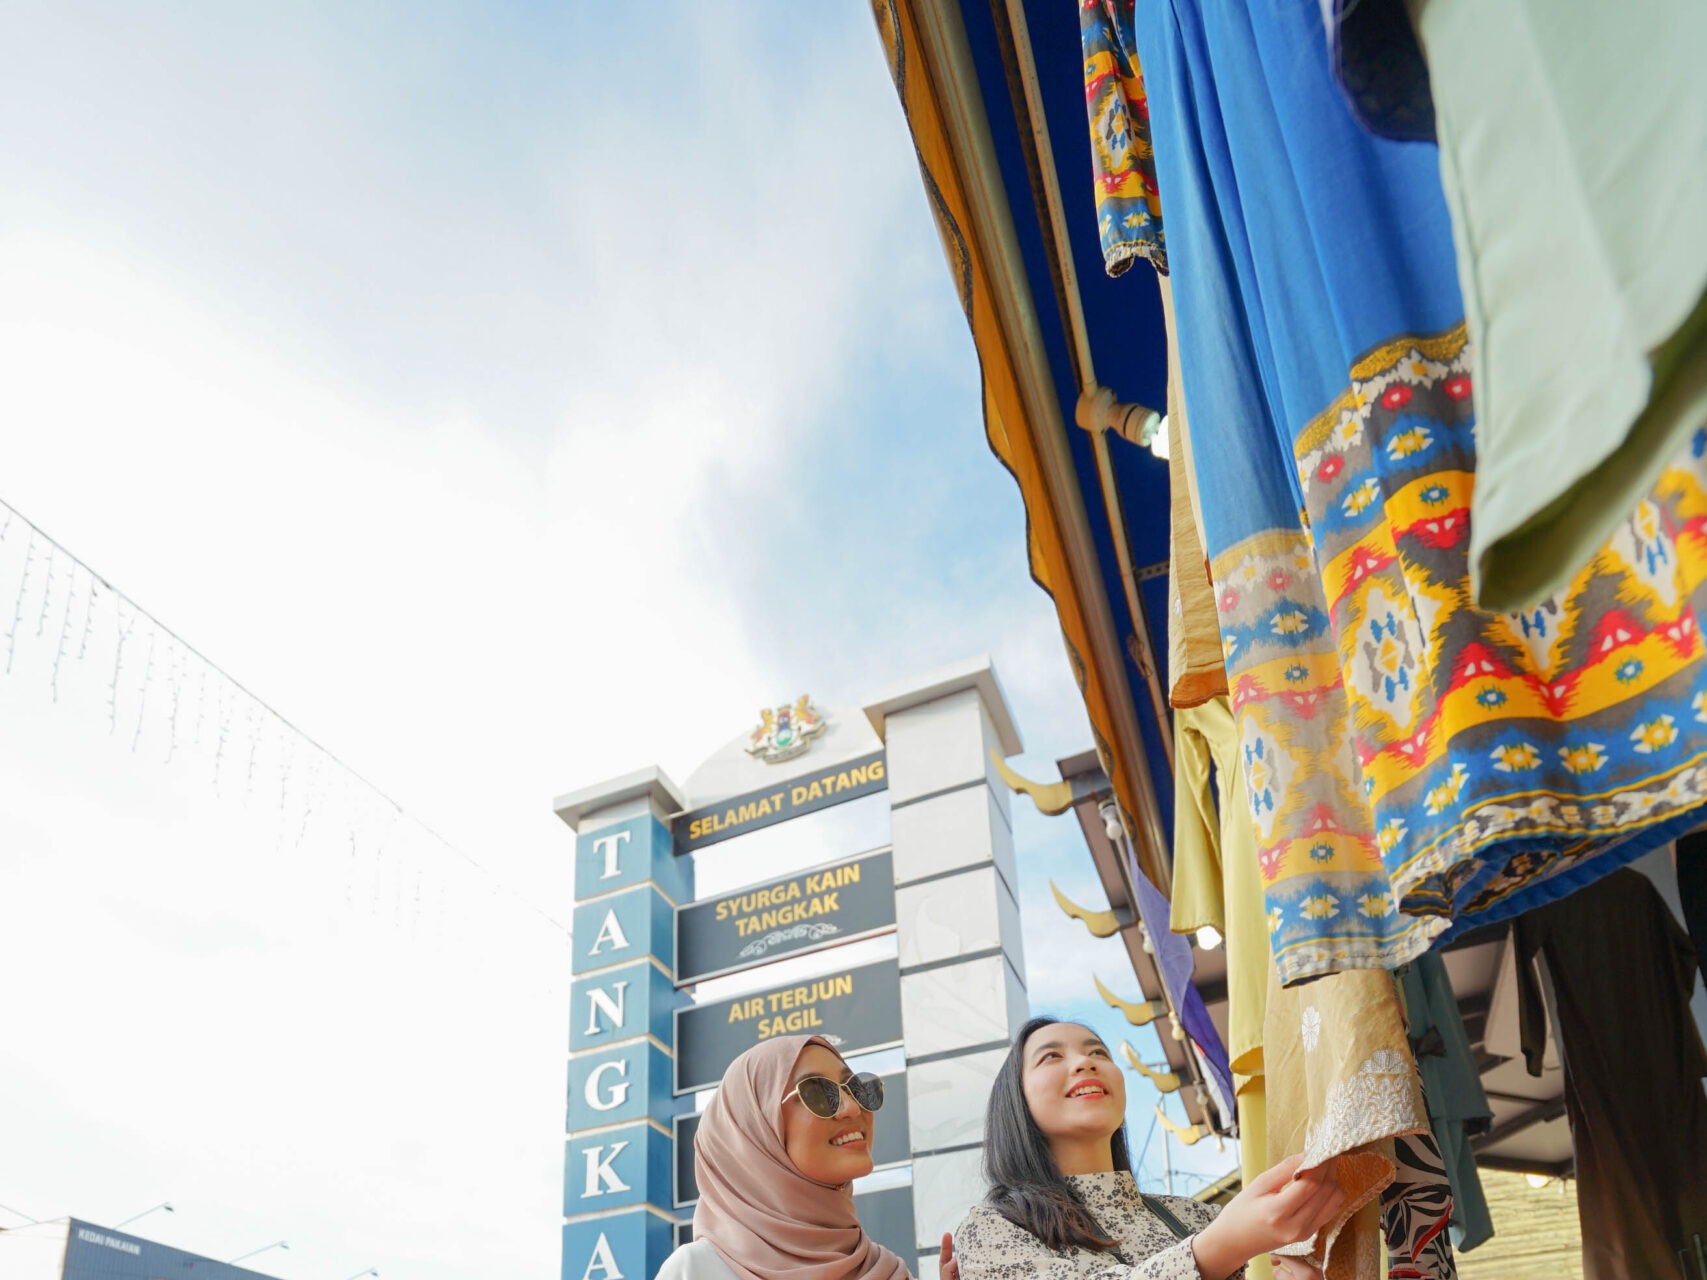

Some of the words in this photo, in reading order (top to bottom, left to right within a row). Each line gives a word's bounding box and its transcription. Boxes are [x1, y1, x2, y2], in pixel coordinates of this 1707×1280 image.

[689, 793, 784, 839] SELAMAT
[791, 761, 885, 806] DATANG
[716, 882, 801, 921] SYURGA
[806, 864, 860, 894] KAIN
[735, 892, 840, 937] TANGKAK
[728, 998, 765, 1024] AIR
[767, 974, 853, 1012] TERJUN
[757, 1008, 823, 1039] SAGIL
